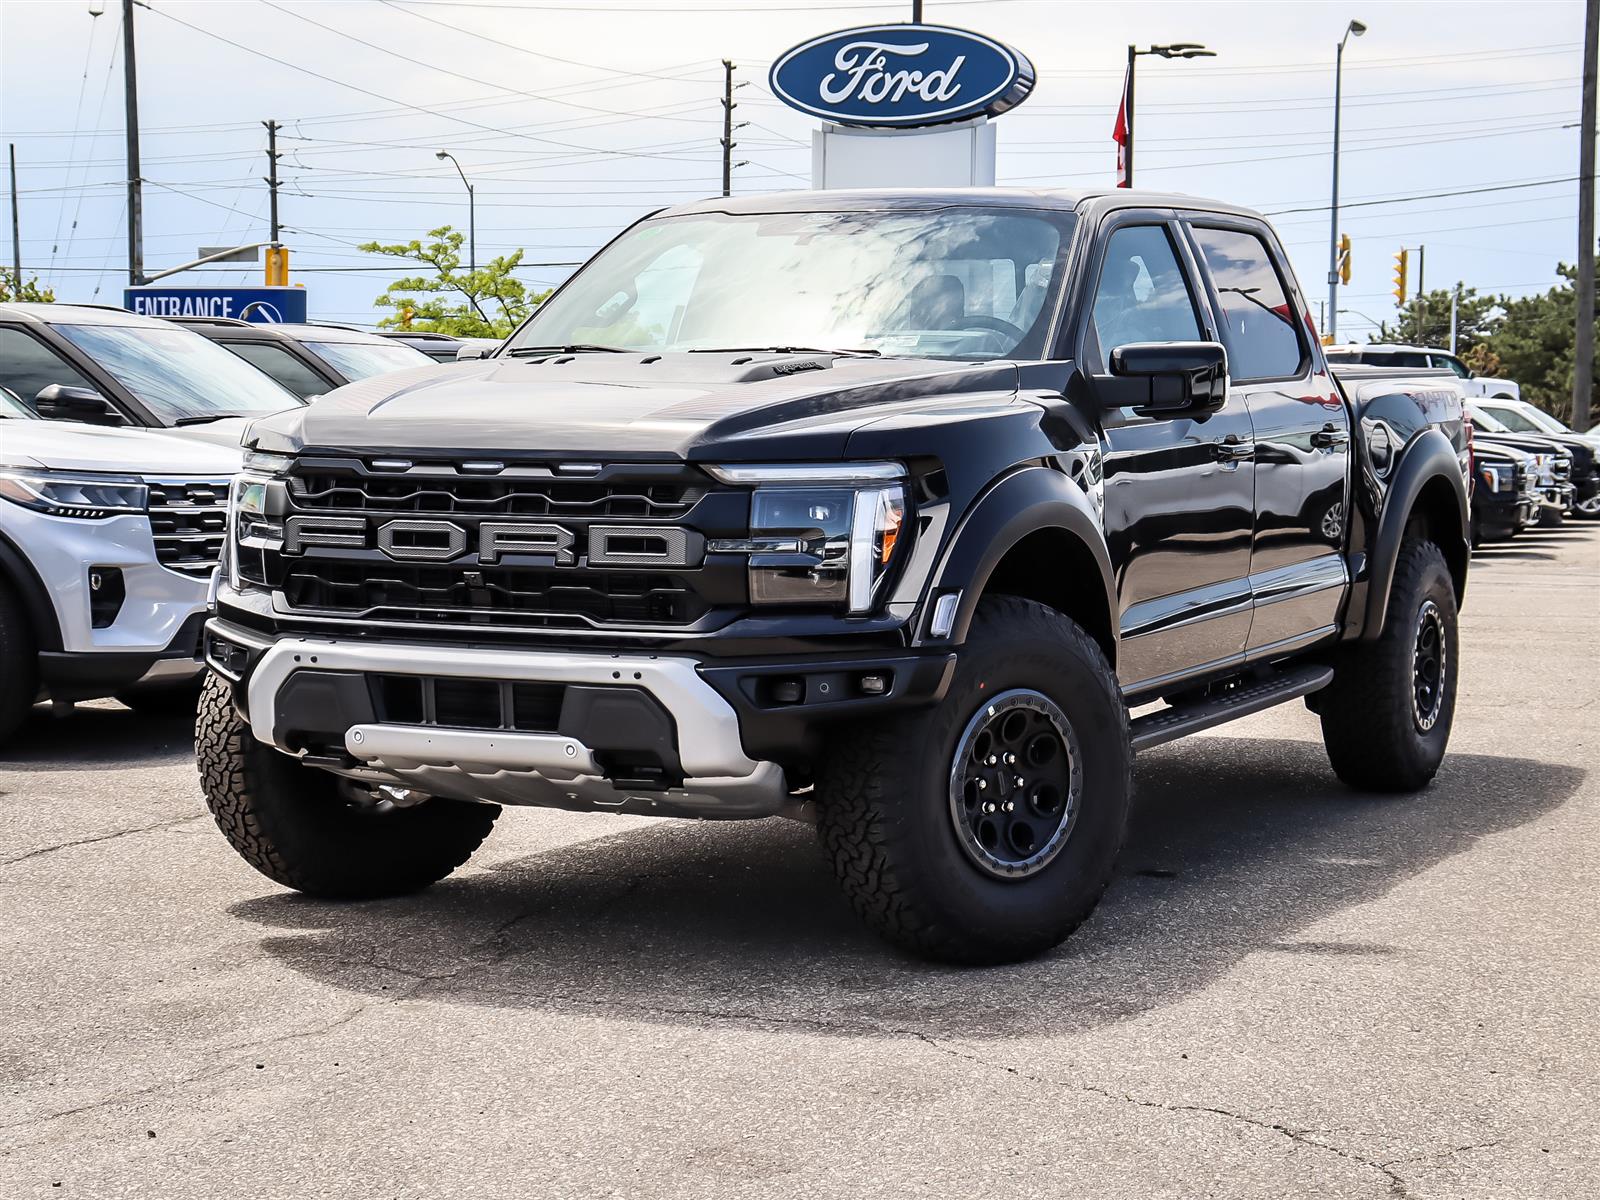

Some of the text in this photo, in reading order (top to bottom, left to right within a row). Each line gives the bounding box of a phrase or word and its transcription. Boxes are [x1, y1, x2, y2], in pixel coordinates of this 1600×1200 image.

[820, 41, 966, 103] Ford
[135, 297, 233, 318] ENTRANCE
[286, 515, 690, 566] FORD
